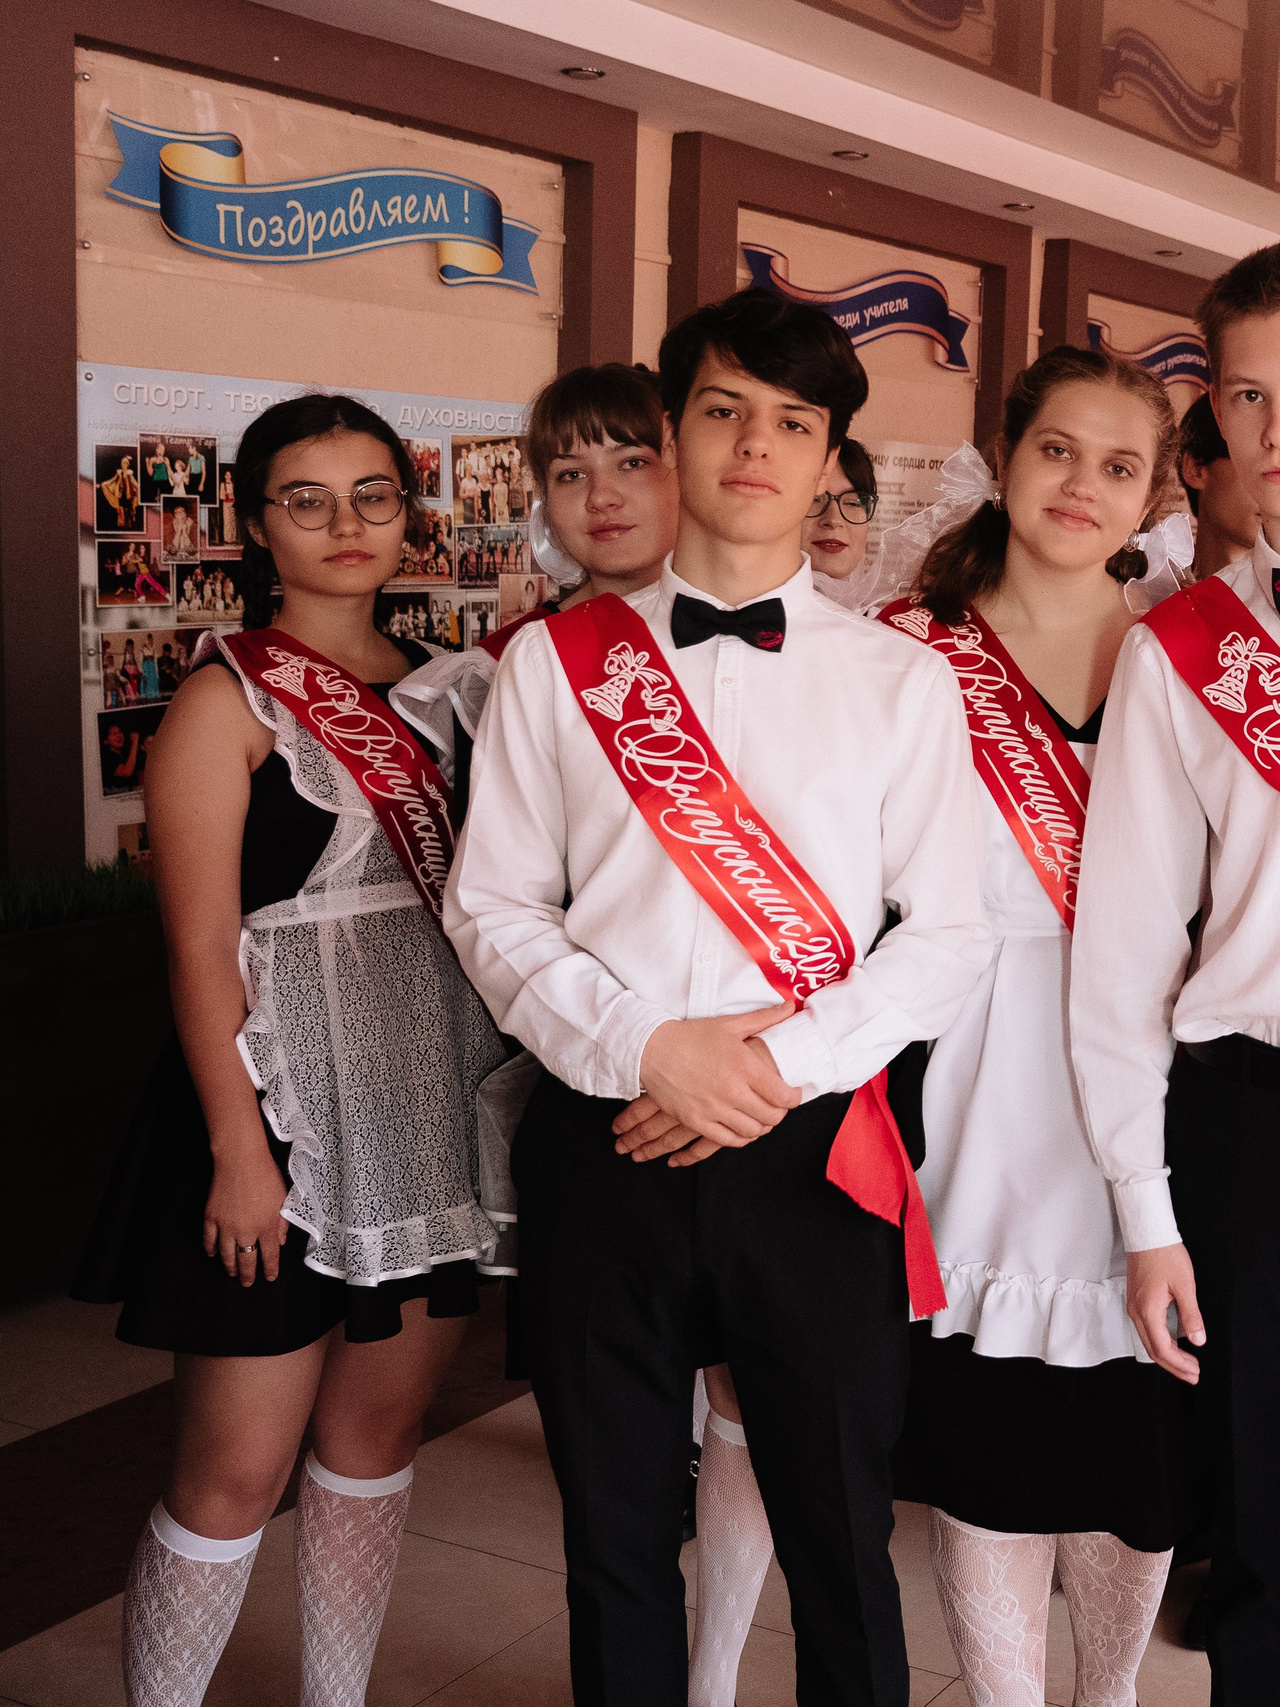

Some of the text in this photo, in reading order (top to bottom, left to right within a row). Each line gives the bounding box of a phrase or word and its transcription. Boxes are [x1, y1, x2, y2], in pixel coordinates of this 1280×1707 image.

[216, 187, 450, 256] Поздравляем
[863, 298, 909, 327] учителя
[113, 383, 214, 414] спорт.
[893, 456, 926, 472] сердца
